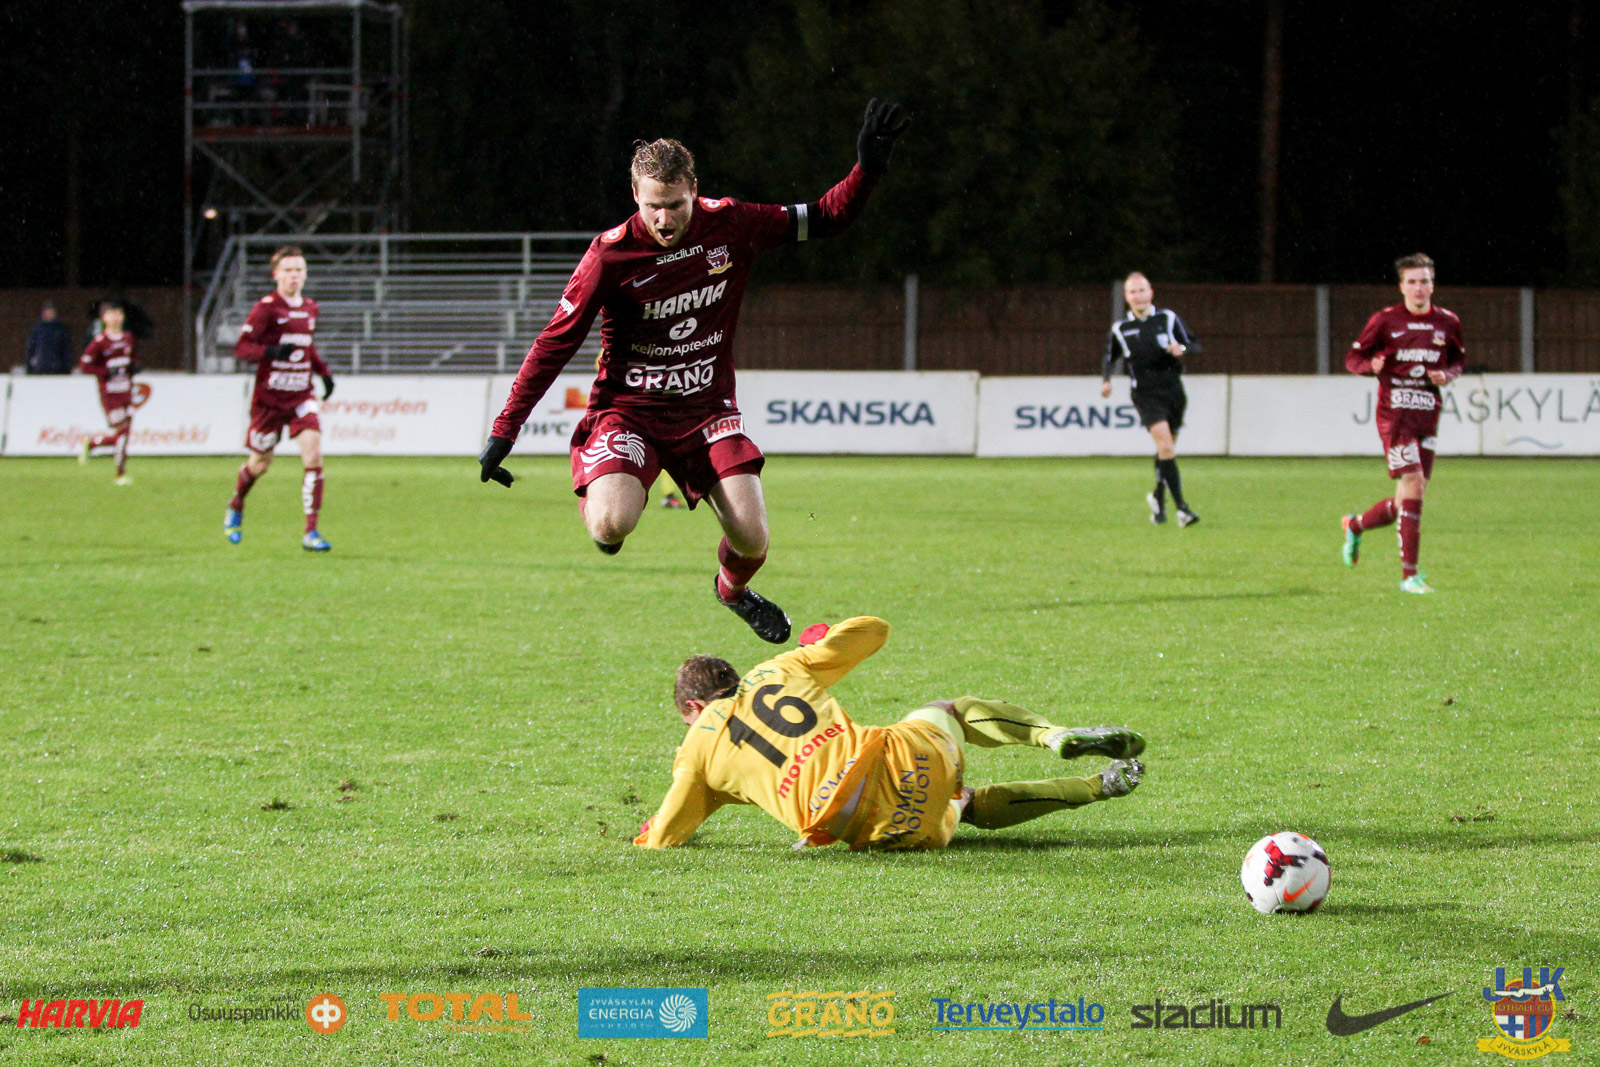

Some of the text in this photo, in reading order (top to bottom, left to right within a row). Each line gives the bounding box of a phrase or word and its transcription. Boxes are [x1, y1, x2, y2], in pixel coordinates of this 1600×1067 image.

[656, 245, 704, 266] stadium
[643, 280, 728, 319] HARVIA
[631, 330, 723, 357] KeljonApteekki
[625, 364, 714, 391] GRANO
[320, 397, 428, 419] erveyden
[767, 400, 935, 426] SKANSKA
[1015, 405, 1137, 429] SKANS
[726, 683, 818, 769] 16
[777, 722, 846, 799] motonet
